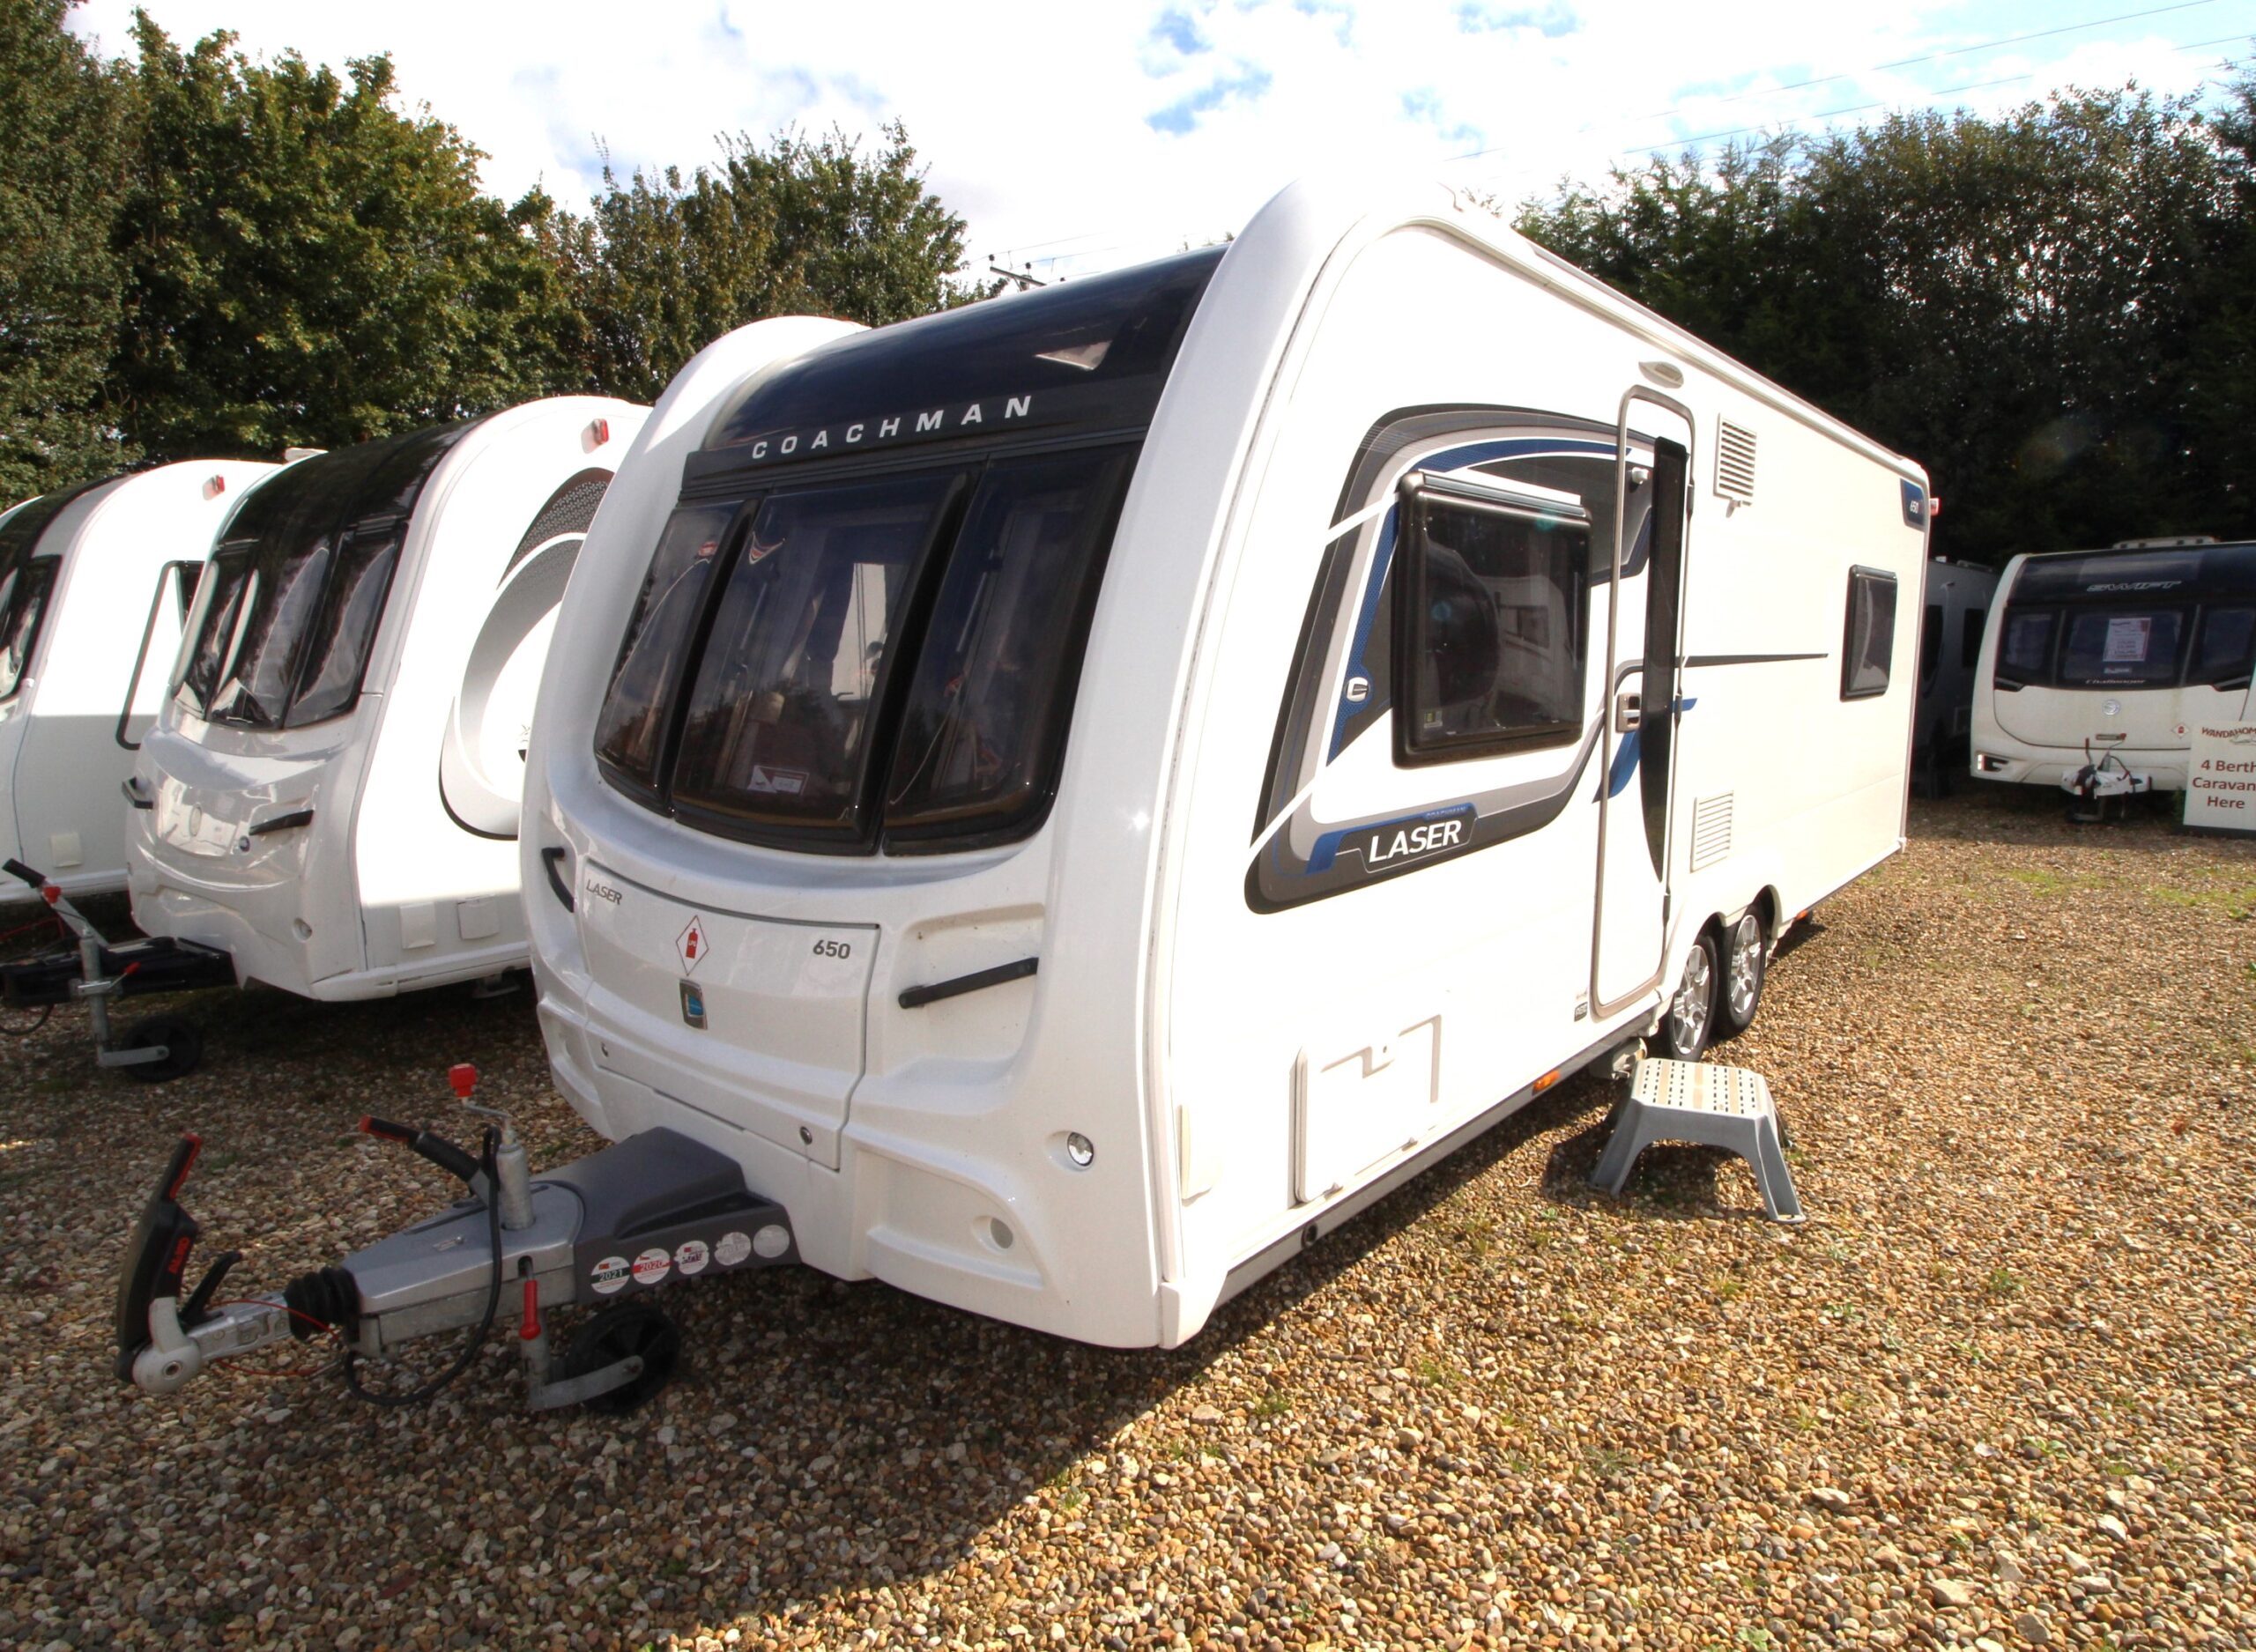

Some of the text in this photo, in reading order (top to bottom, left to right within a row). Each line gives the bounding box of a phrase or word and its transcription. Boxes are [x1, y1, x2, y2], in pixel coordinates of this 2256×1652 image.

[753, 396, 1031, 459] COACHMAN
[2087, 581, 2182, 592] SWIFT
[2200, 759, 2210, 770] 4
[2207, 796, 2245, 809] Here
[1369, 819, 1462, 863] LASER
[586, 878, 622, 906] LASER
[813, 939, 851, 959] 650
[600, 1269, 623, 1281] 2021
